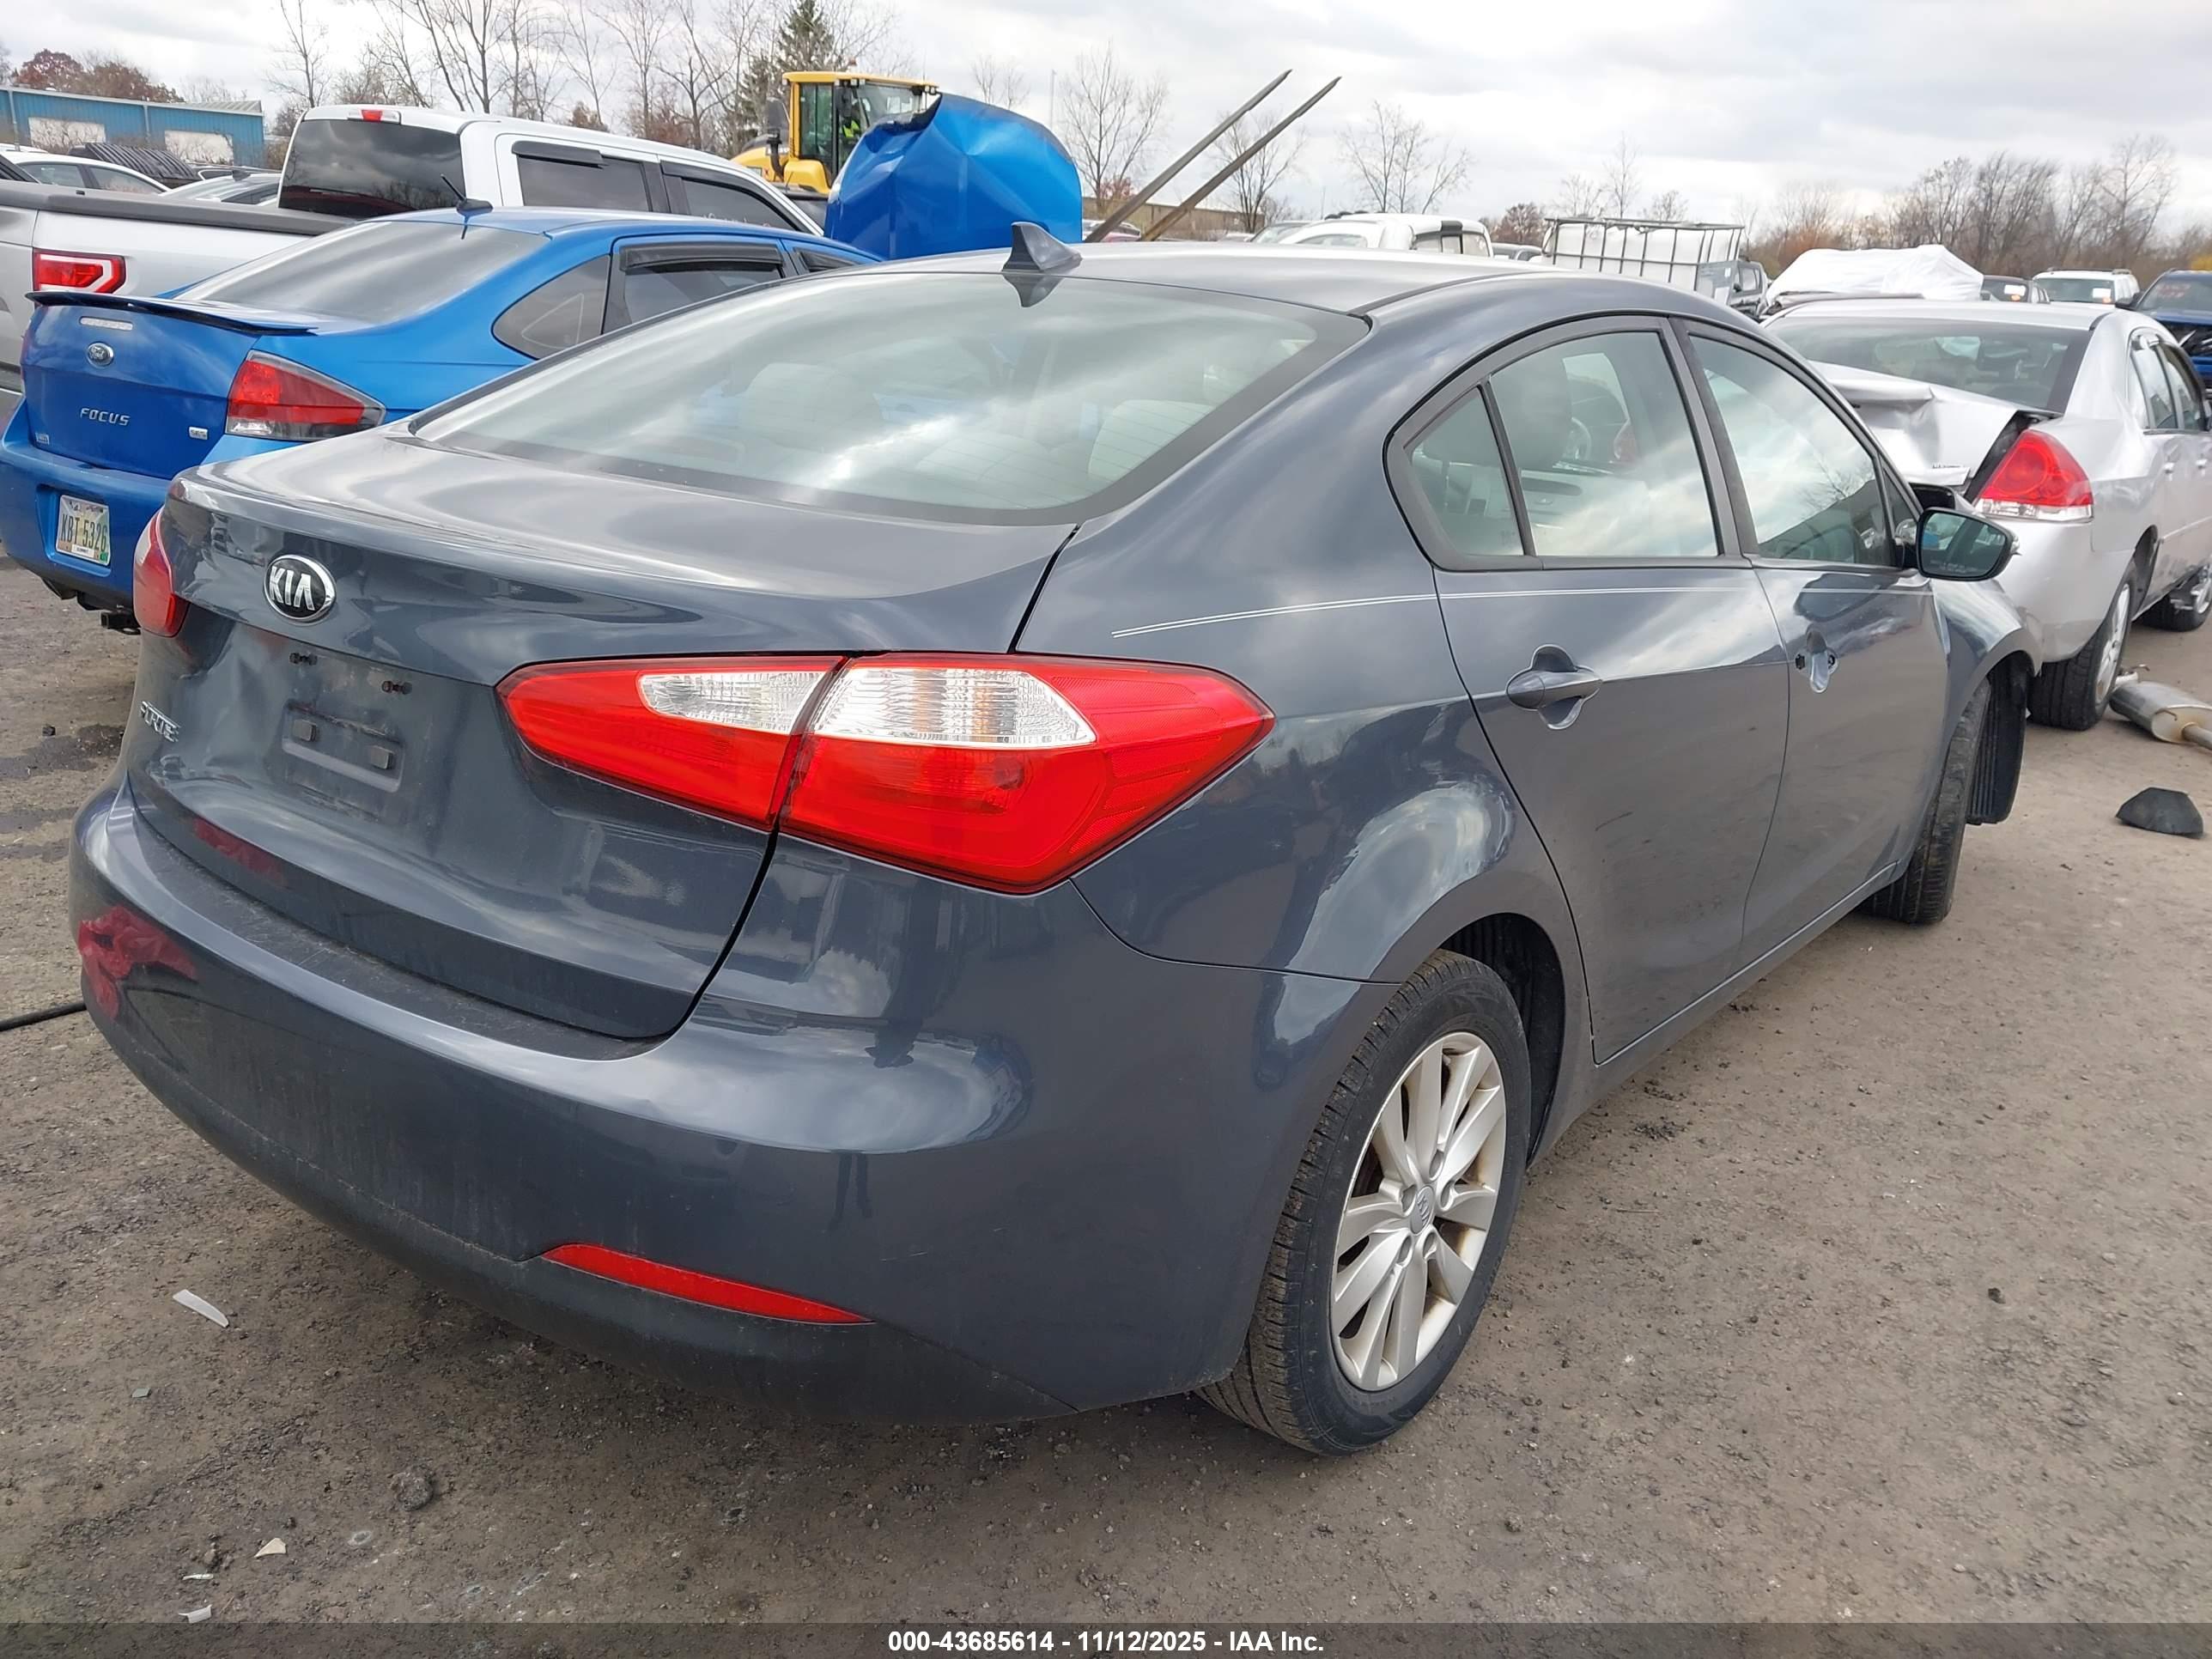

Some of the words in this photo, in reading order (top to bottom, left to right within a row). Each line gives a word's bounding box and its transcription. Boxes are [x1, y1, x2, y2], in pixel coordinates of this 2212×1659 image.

[80, 408, 131, 426] FOCUS
[60, 514, 80, 544] KBT
[82, 519, 108, 552] 5326
[269, 566, 315, 611] KIA
